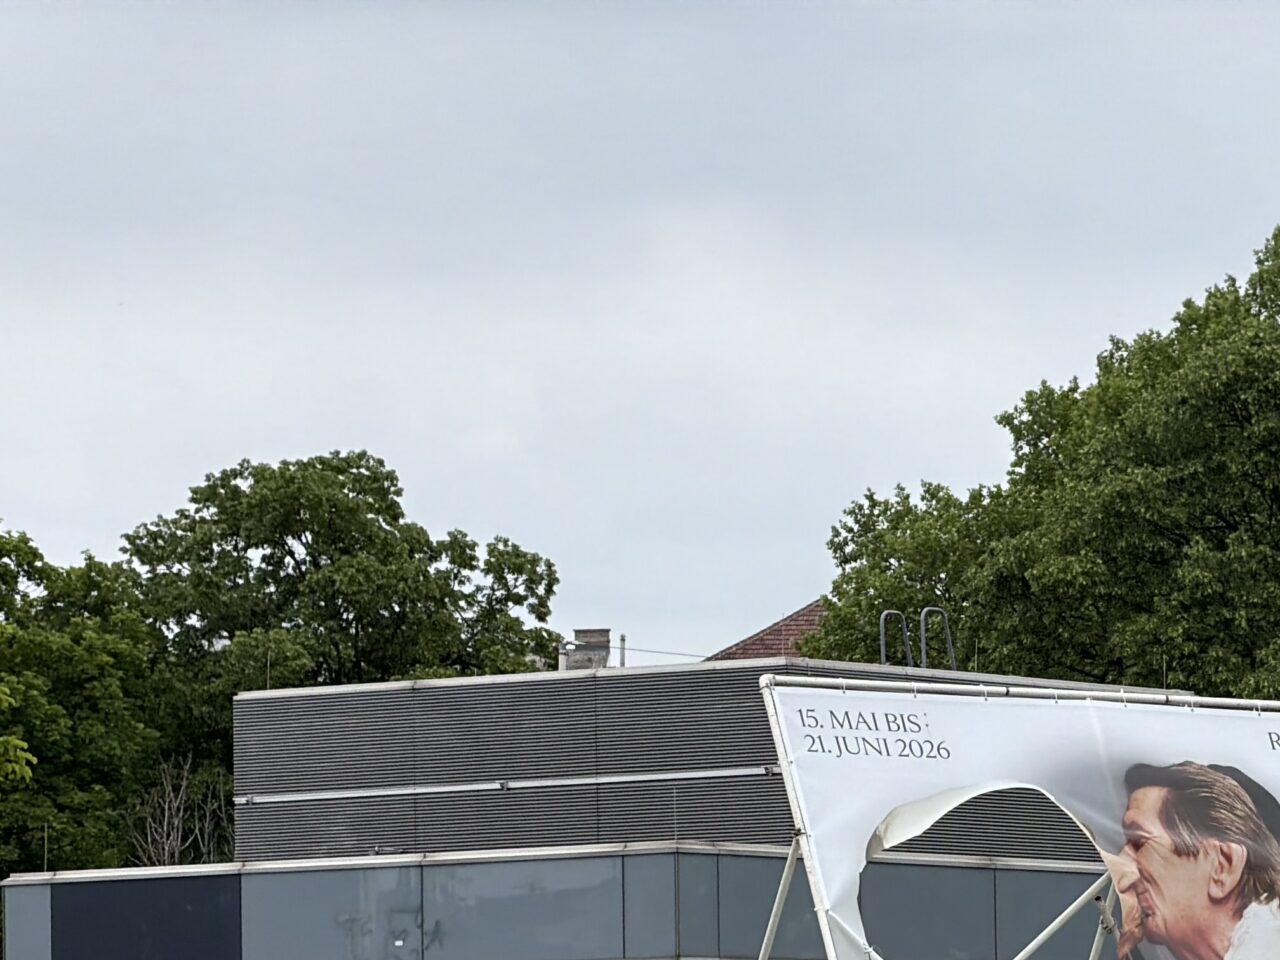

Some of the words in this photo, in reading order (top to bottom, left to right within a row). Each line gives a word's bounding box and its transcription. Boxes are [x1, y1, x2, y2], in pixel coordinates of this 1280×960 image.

[797, 708, 824, 729] 15.
[829, 709, 880, 732] MAI
[884, 712, 922, 734] BIS
[803, 734, 832, 754] 21.
[834, 735, 891, 758] JUNI
[895, 738, 951, 760] 2026
